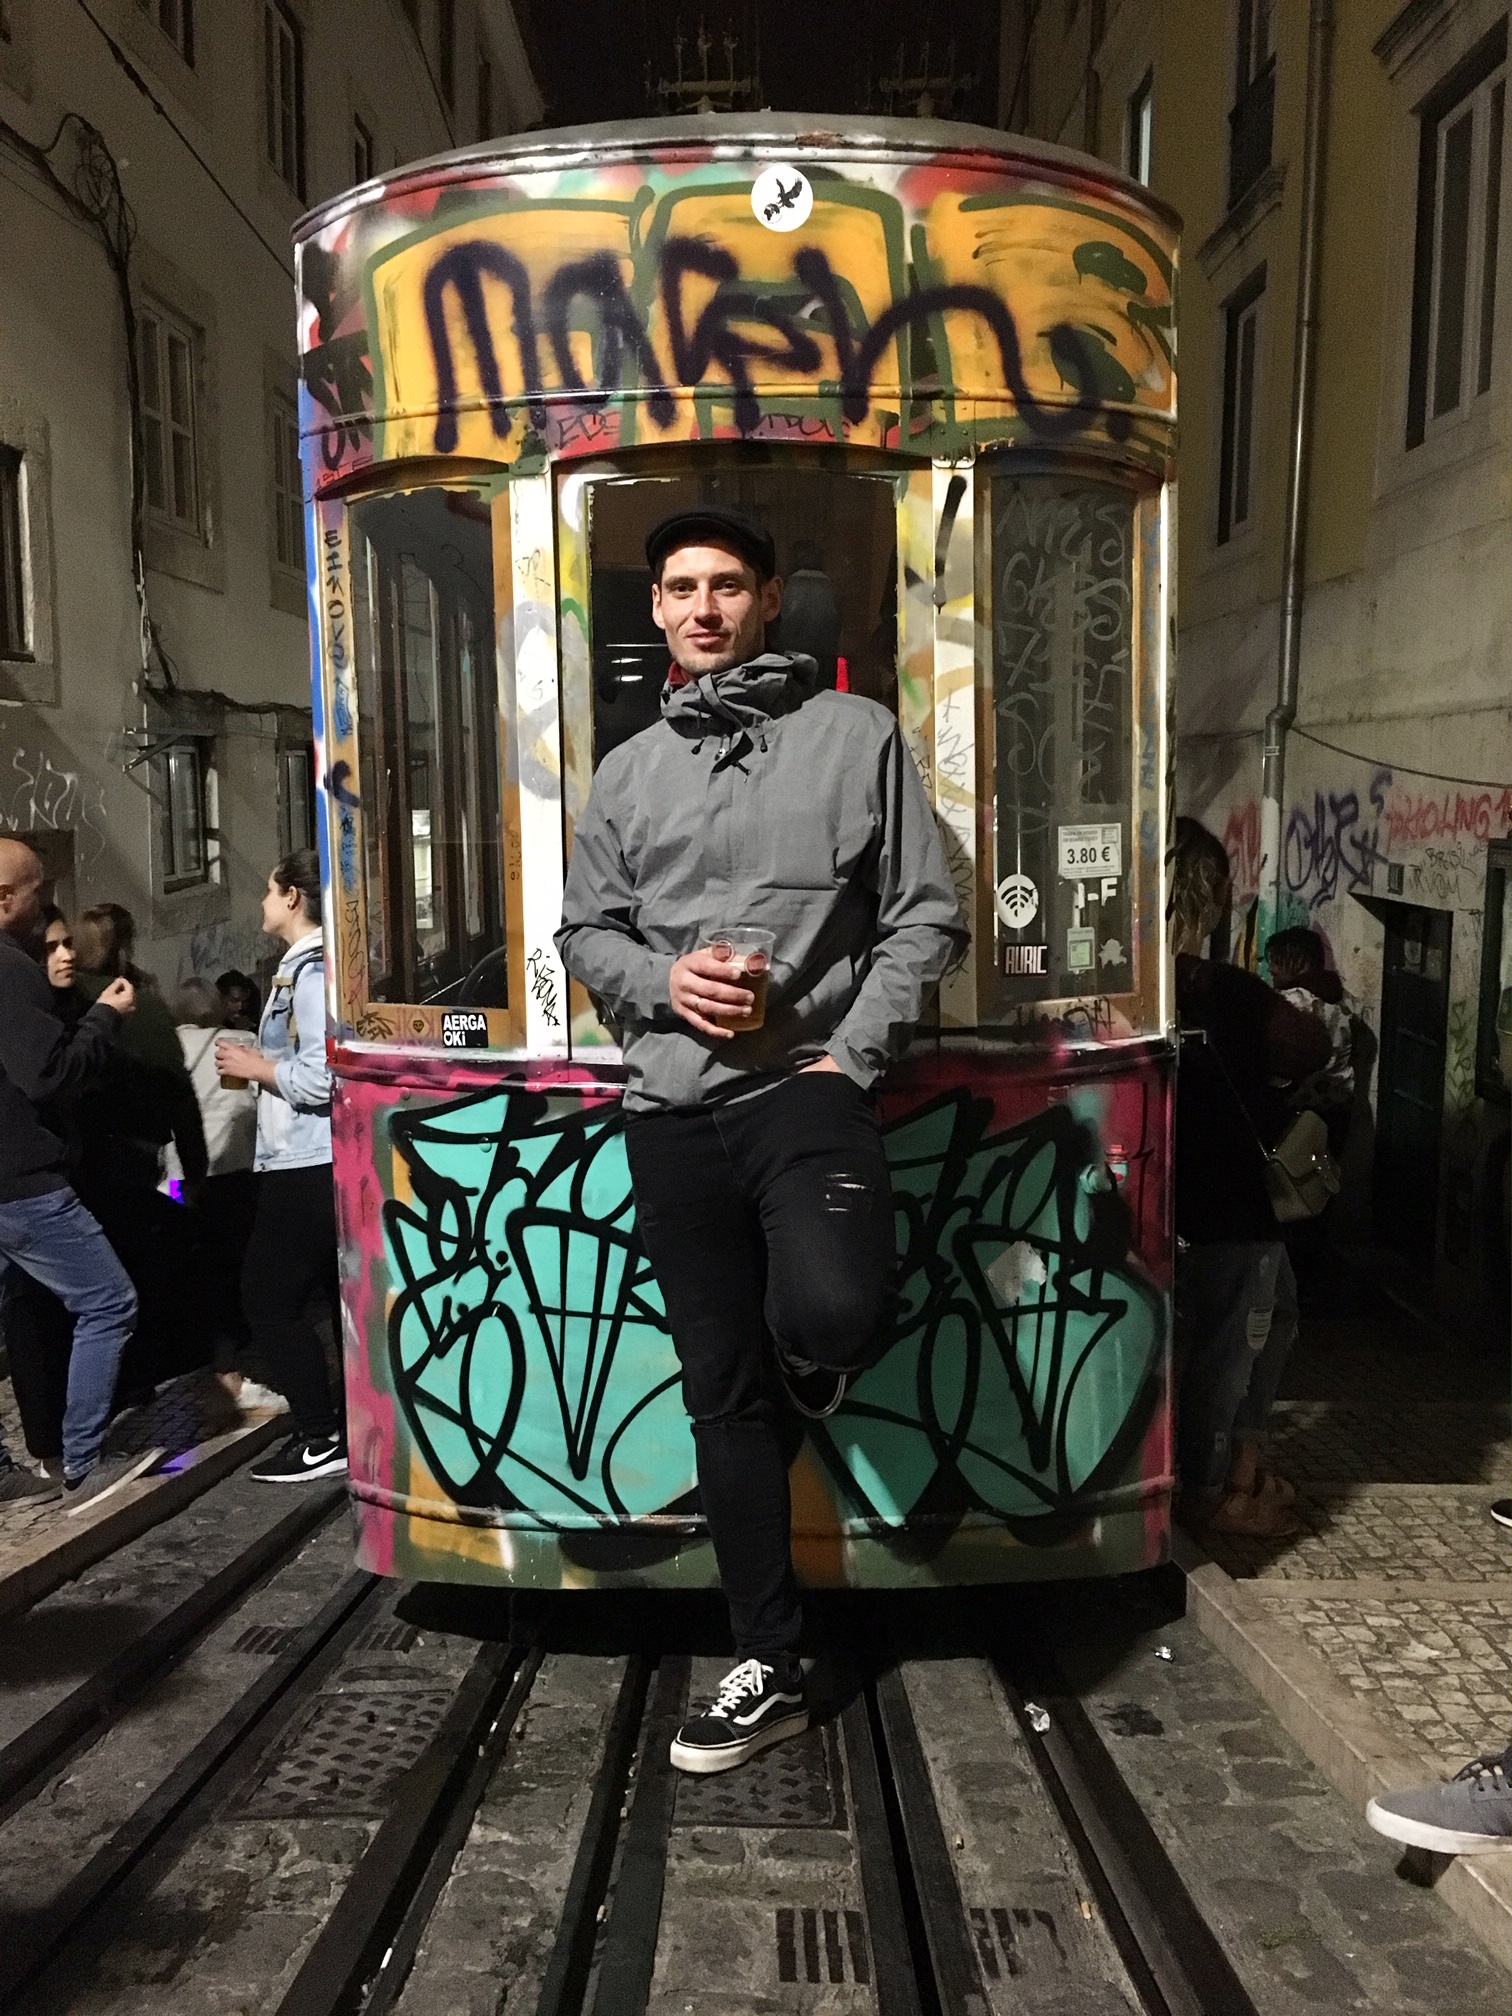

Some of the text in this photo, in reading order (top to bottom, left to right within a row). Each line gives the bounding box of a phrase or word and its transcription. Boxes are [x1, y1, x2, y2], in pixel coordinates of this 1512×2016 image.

[1067, 846, 1110, 864] 3.80 €
[1005, 945, 1047, 974] AURIC
[443, 1014, 487, 1031] AERGA
